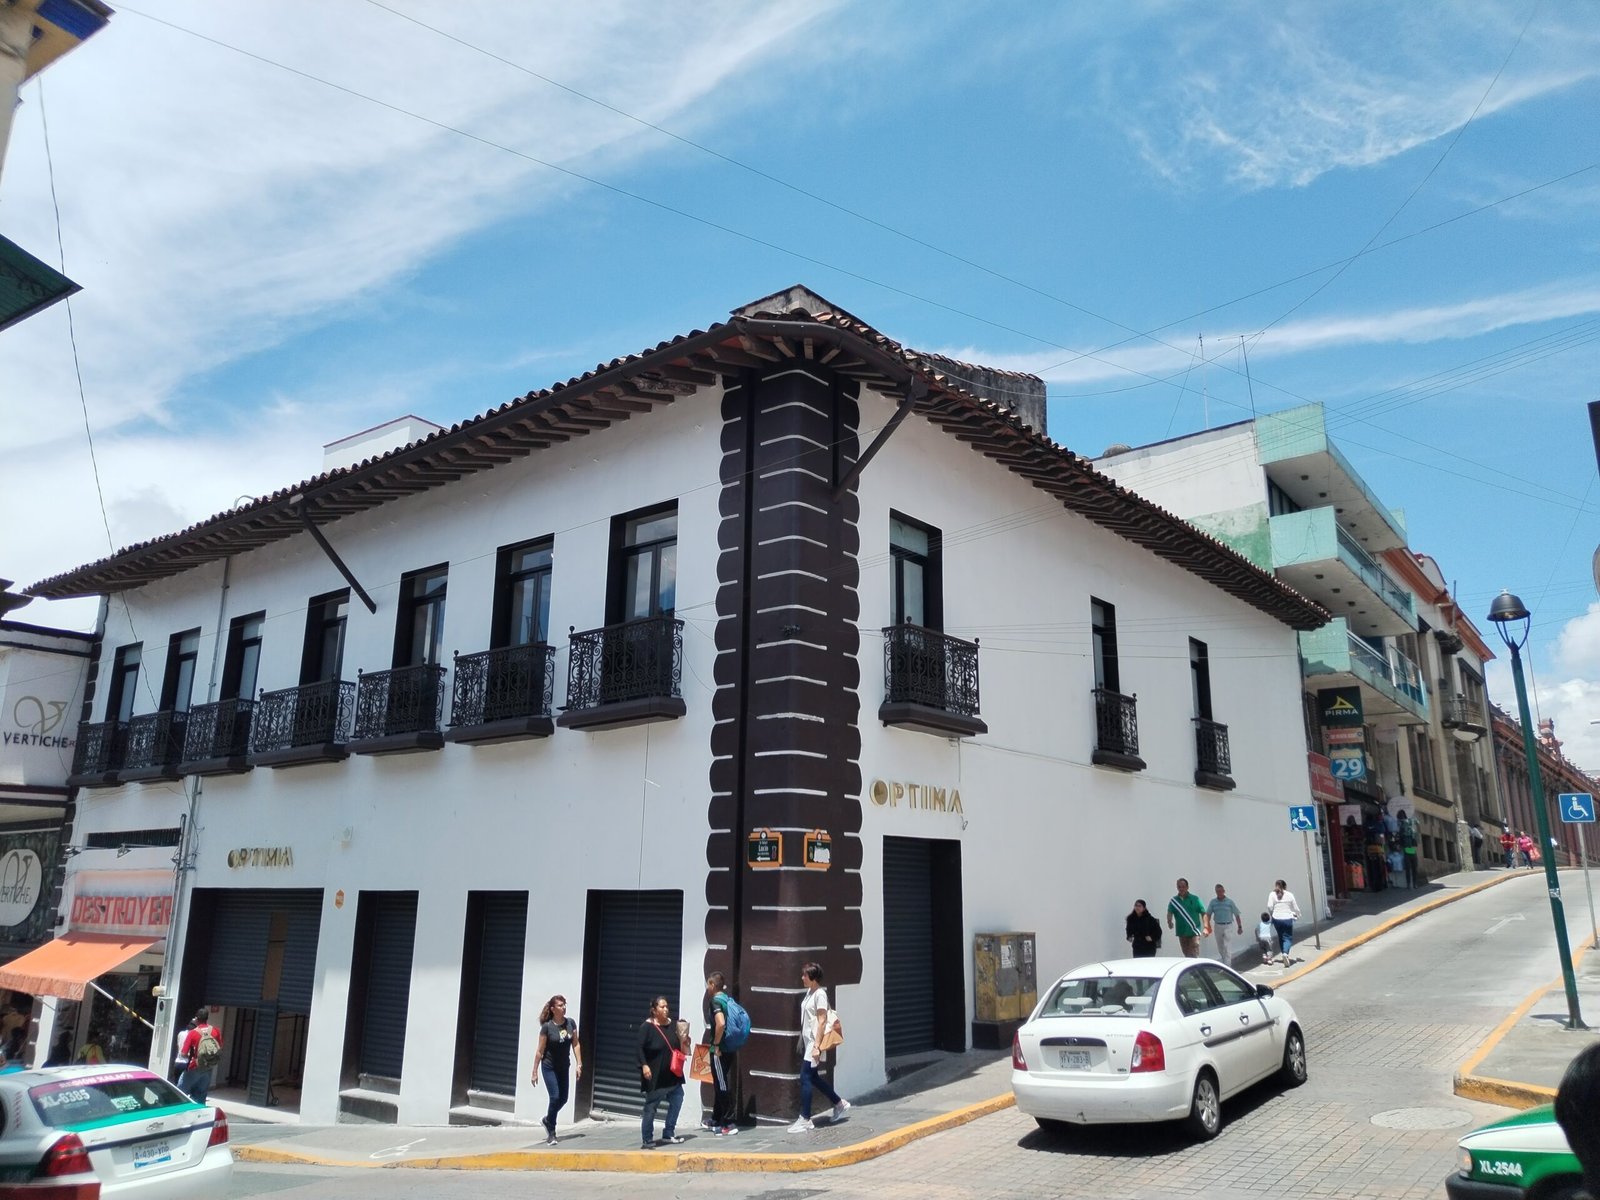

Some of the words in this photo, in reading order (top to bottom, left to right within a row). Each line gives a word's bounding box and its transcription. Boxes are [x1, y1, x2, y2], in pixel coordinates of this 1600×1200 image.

[3, 731, 69, 748] VERTICHE
[1335, 758, 1361, 777] 29
[869, 779, 964, 814] OPTIMA
[227, 846, 294, 869] OPTIMA
[71, 895, 172, 925] DESTROYER
[37, 1088, 90, 1110] XL-6385
[1479, 1160, 1523, 1177] XL-2544
